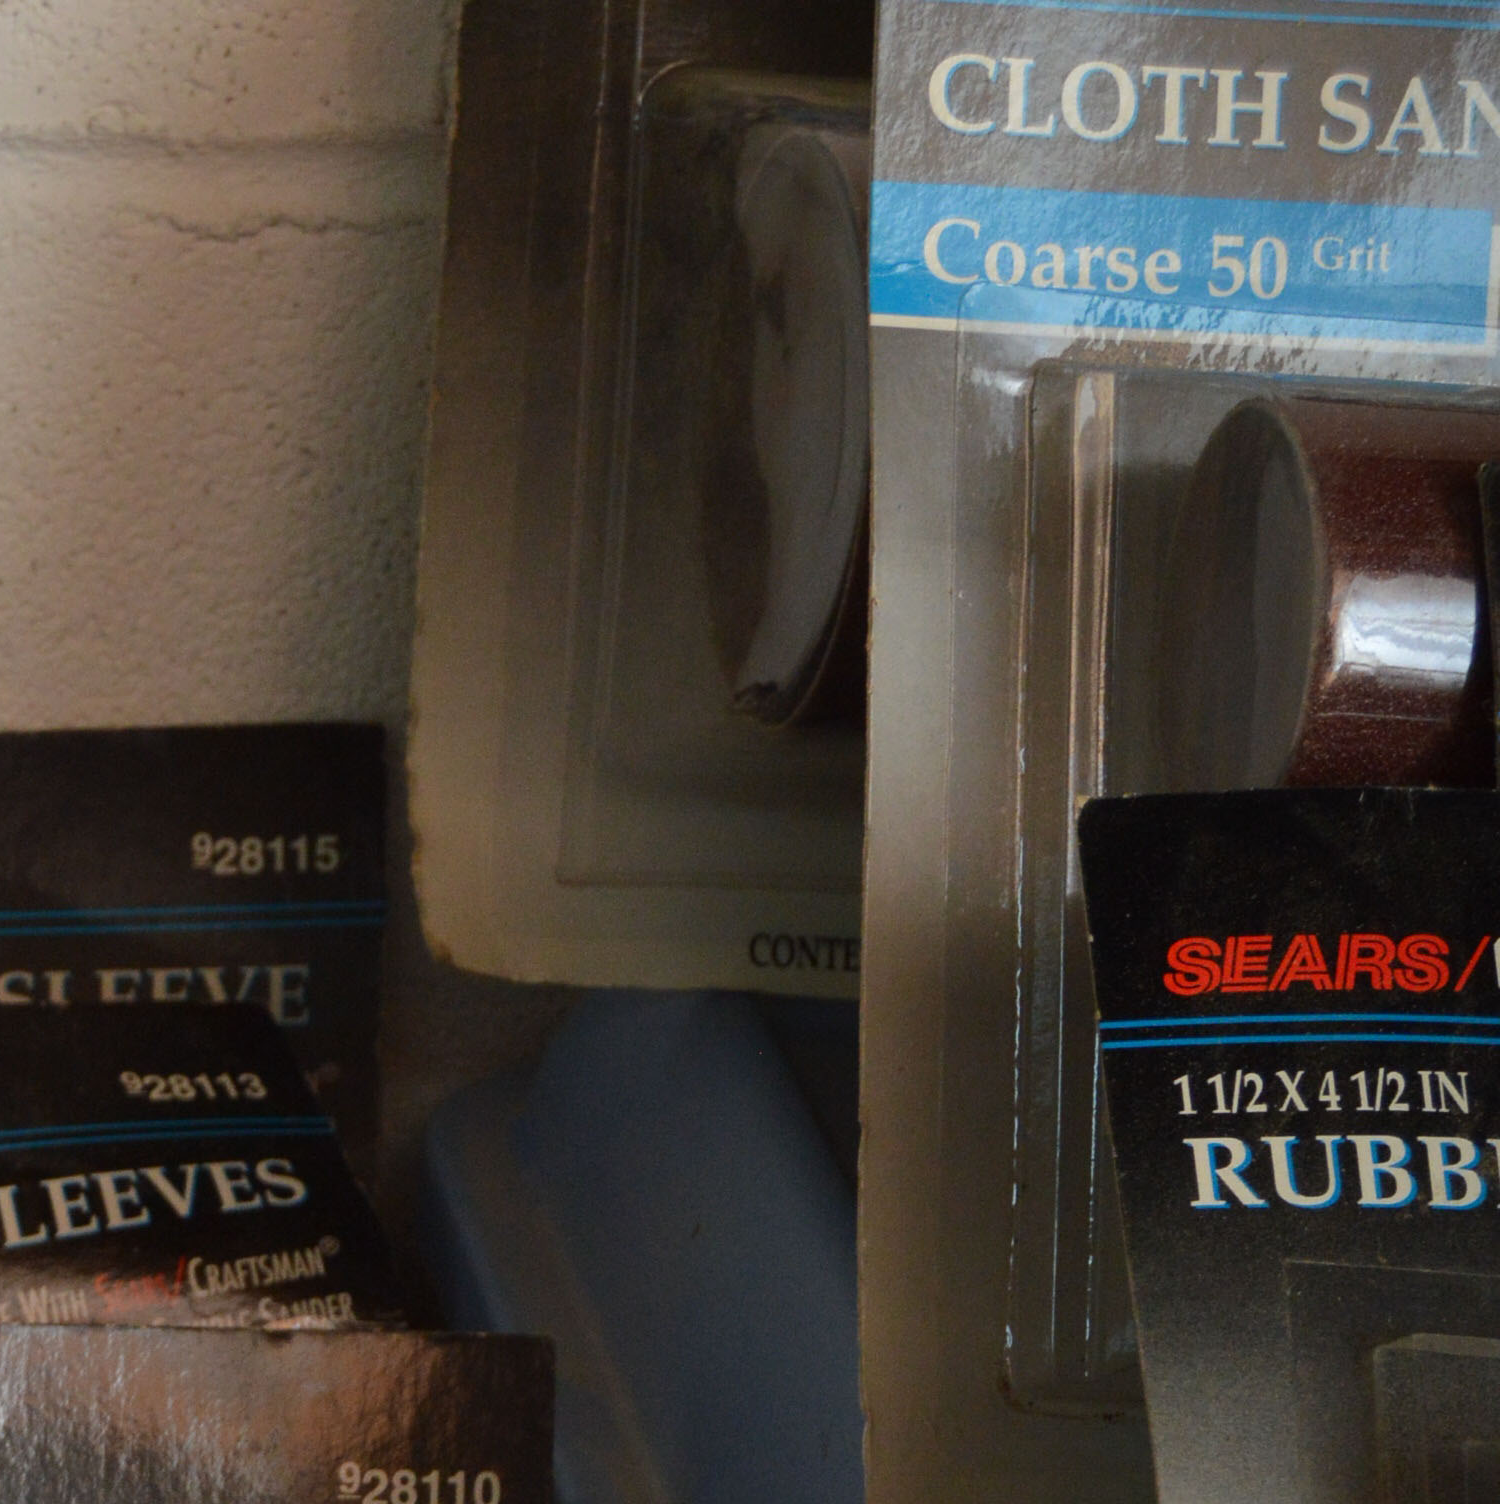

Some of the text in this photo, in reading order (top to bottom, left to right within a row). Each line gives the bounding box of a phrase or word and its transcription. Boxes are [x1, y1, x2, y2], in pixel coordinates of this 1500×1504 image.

[928, 52, 1288, 150] CLOTH
[922, 216, 1391, 299] Coarse 50 Grit
[190, 831, 341, 876] 928115
[120, 1071, 266, 1101] 928113
[1173, 1067, 1469, 1115] 1 1/2 X 4 1/2 IN
